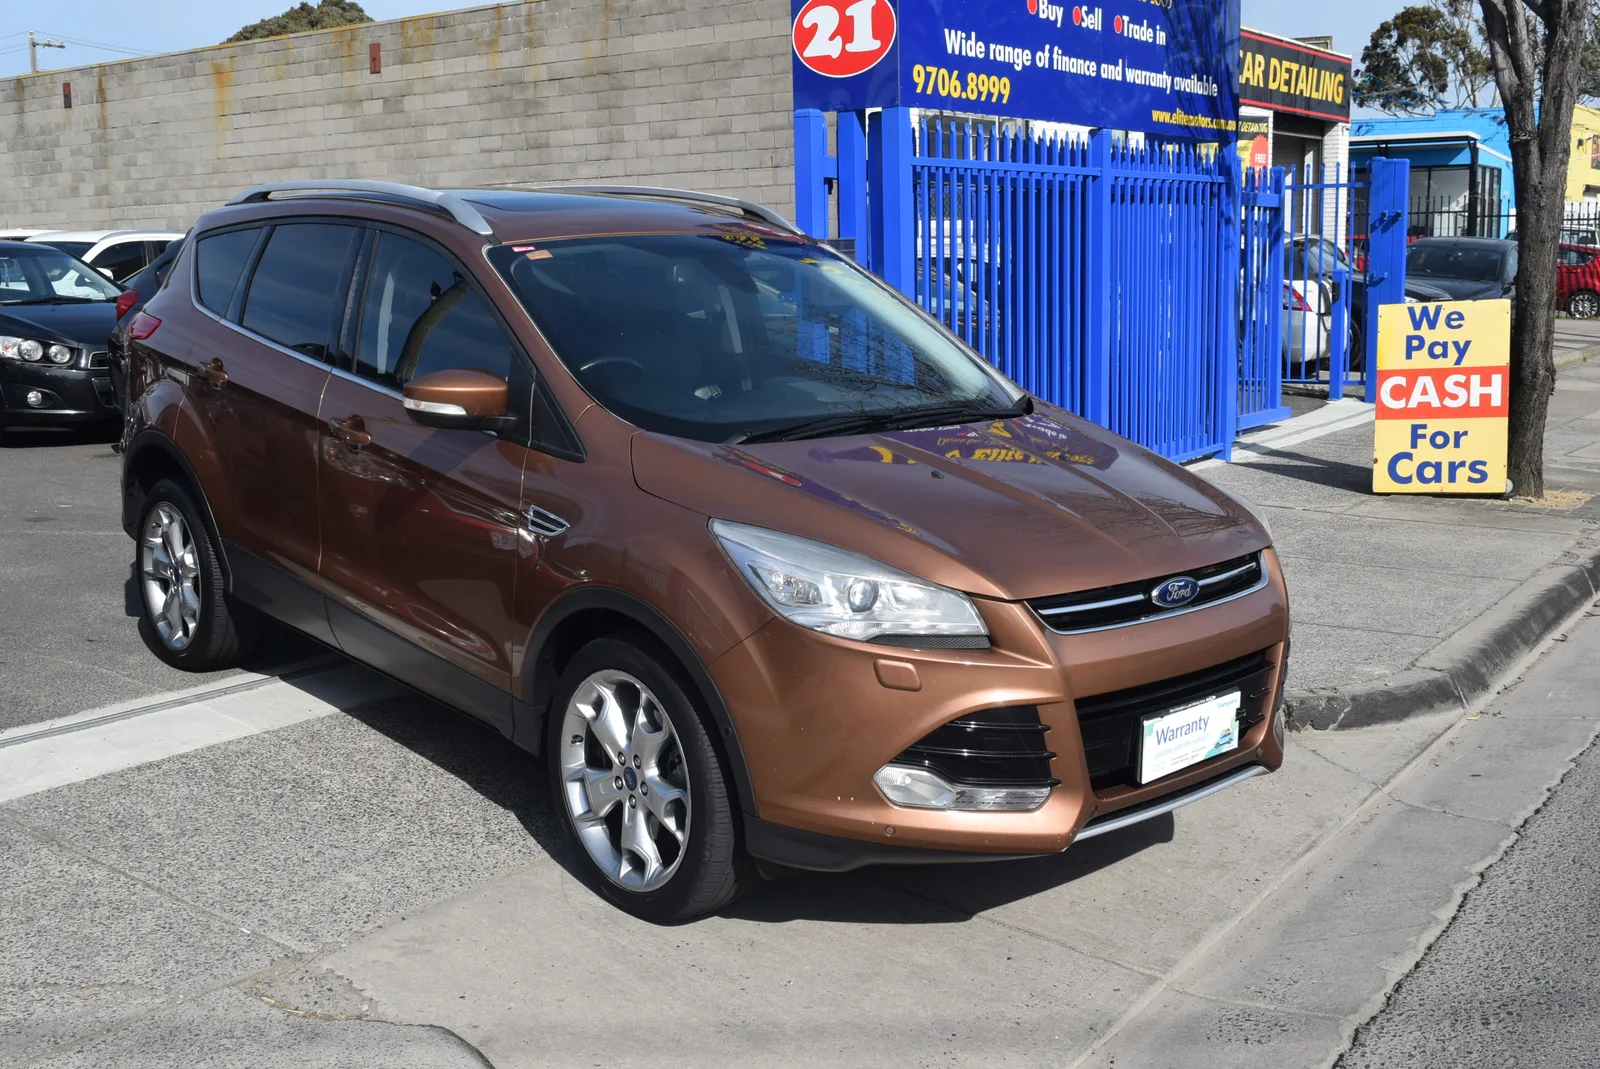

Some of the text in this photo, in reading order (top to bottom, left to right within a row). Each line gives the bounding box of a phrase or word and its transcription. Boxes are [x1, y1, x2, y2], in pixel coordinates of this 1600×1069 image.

[802, 0, 881, 58] 21
[1038, 0, 1064, 28] Buy
[1081, 6, 1102, 31] Sell
[1121, 15, 1167, 46] Trade in
[944, 28, 1218, 97] Wide range of finance and warranty available
[912, 63, 1011, 104] 9706.8999
[1268, 57, 1344, 105] DETAILING
[1151, 107, 1237, 132] www.elitemotors.com.au
[1407, 304, 1465, 330] We
[1405, 334, 1472, 366] Pay
[1380, 373, 1502, 409] CASH
[1410, 423, 1468, 450] For
[1387, 451, 1489, 485] Cars
[1166, 580, 1192, 602] Ford
[1155, 715, 1210, 746] Warranty
